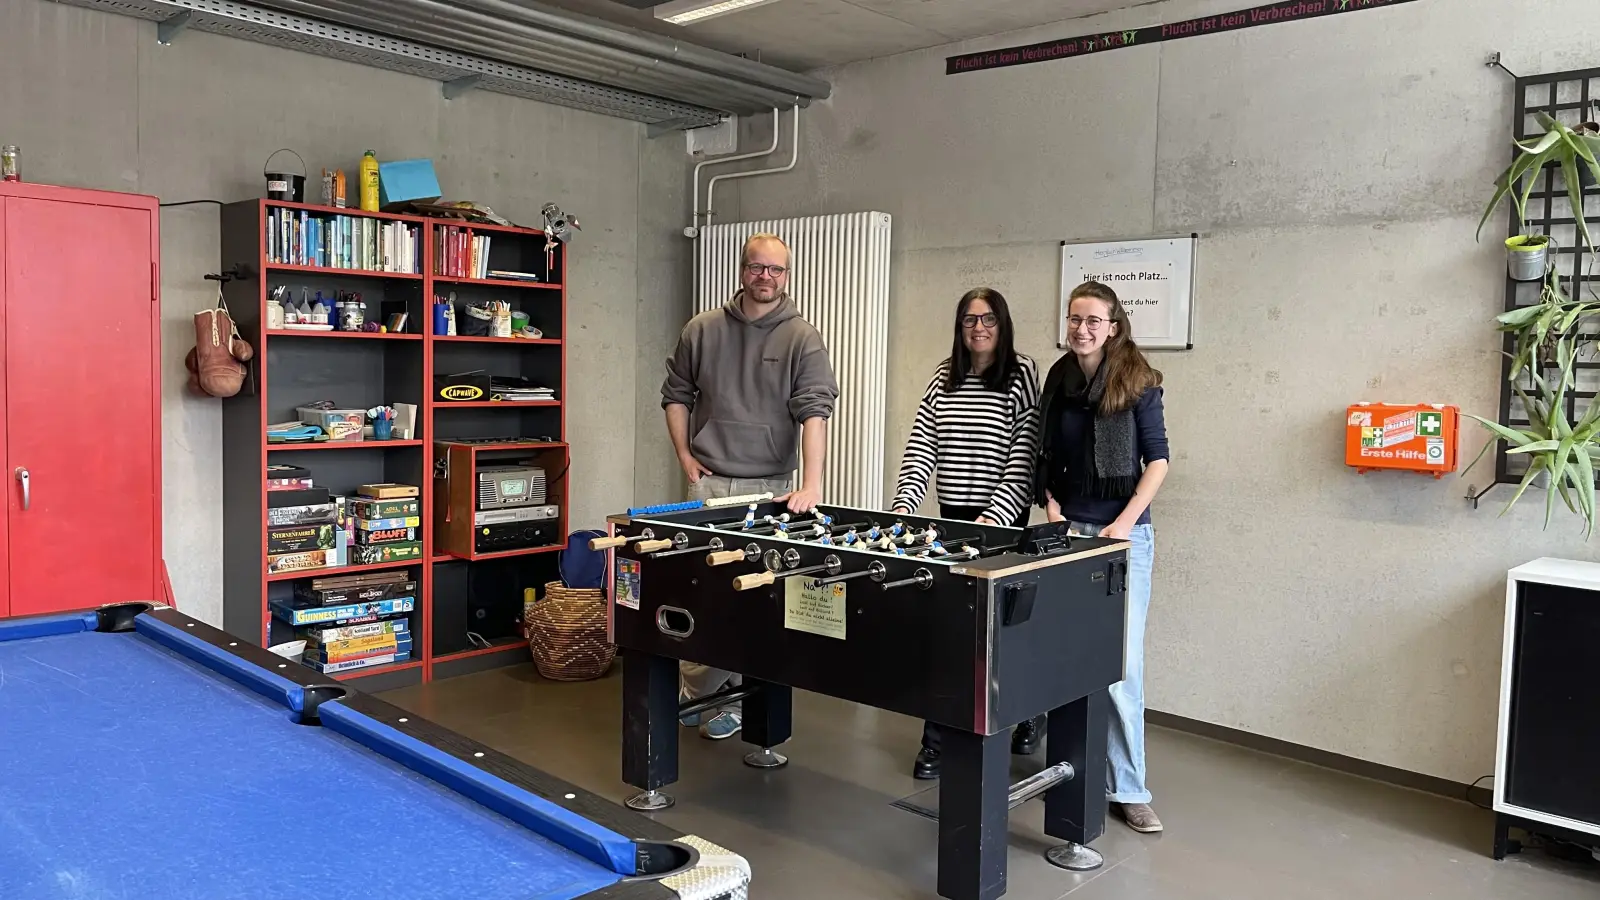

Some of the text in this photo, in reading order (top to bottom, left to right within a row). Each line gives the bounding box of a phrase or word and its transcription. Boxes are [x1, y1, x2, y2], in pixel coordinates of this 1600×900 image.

[1162, 2, 1327, 37] Flucht ist kein Verbrechen!
[955, 44, 1077, 70] Flucht ist kein Verbrechen!
[1083, 272, 1168, 281] Hier ist noch Platz...
[1361, 448, 1425, 460] Erste Hilfe
[272, 529, 315, 539] STERNENFAHRER
[374, 529, 407, 539] BLUFF
[804, 582, 815, 591] Na
[297, 610, 337, 622] GUINNESS
